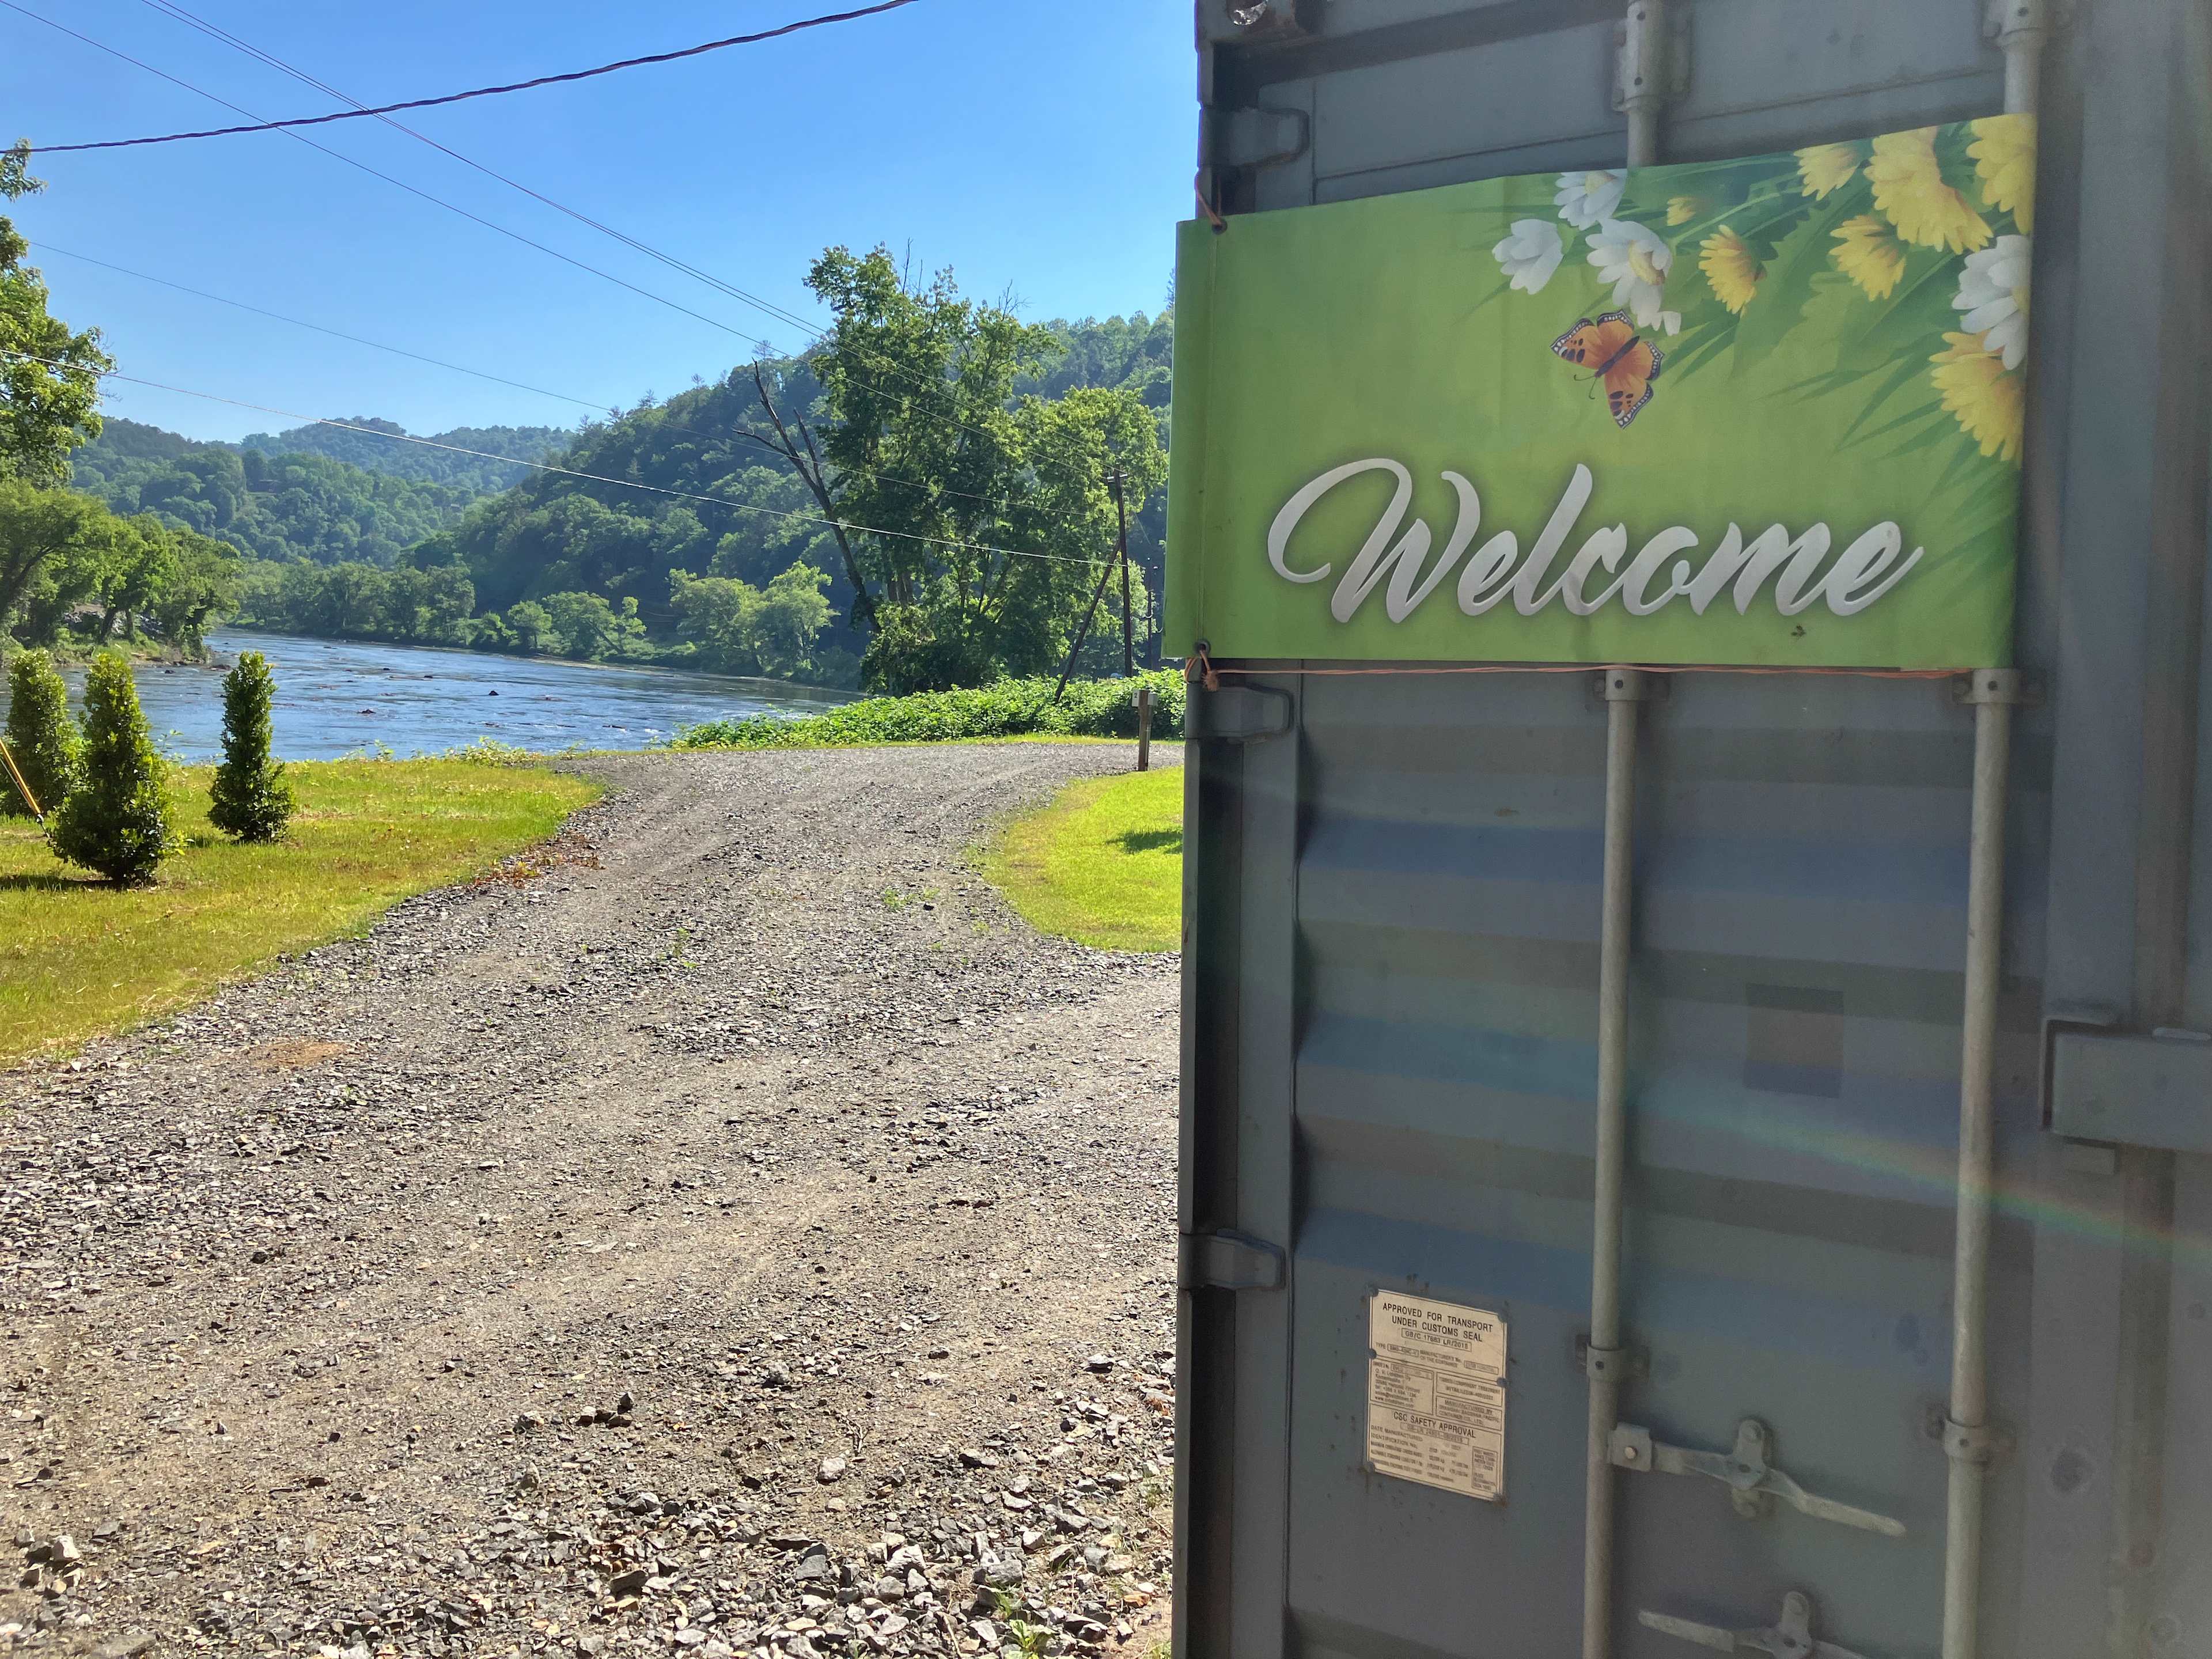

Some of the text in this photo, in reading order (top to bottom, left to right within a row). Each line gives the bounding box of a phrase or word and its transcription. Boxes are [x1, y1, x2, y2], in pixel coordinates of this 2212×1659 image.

[1268, 458, 1924, 623] Welcome
[1382, 1302, 1493, 1332] APPROVED FOR TRANSPORT
[1392, 1316, 1483, 1342] UNDER CUSTOMS SEAL
[1393, 1411, 1408, 1422] CSC
[1410, 1415, 1437, 1429] SAFETY
[1439, 1423, 1476, 1438] APPROVAL
